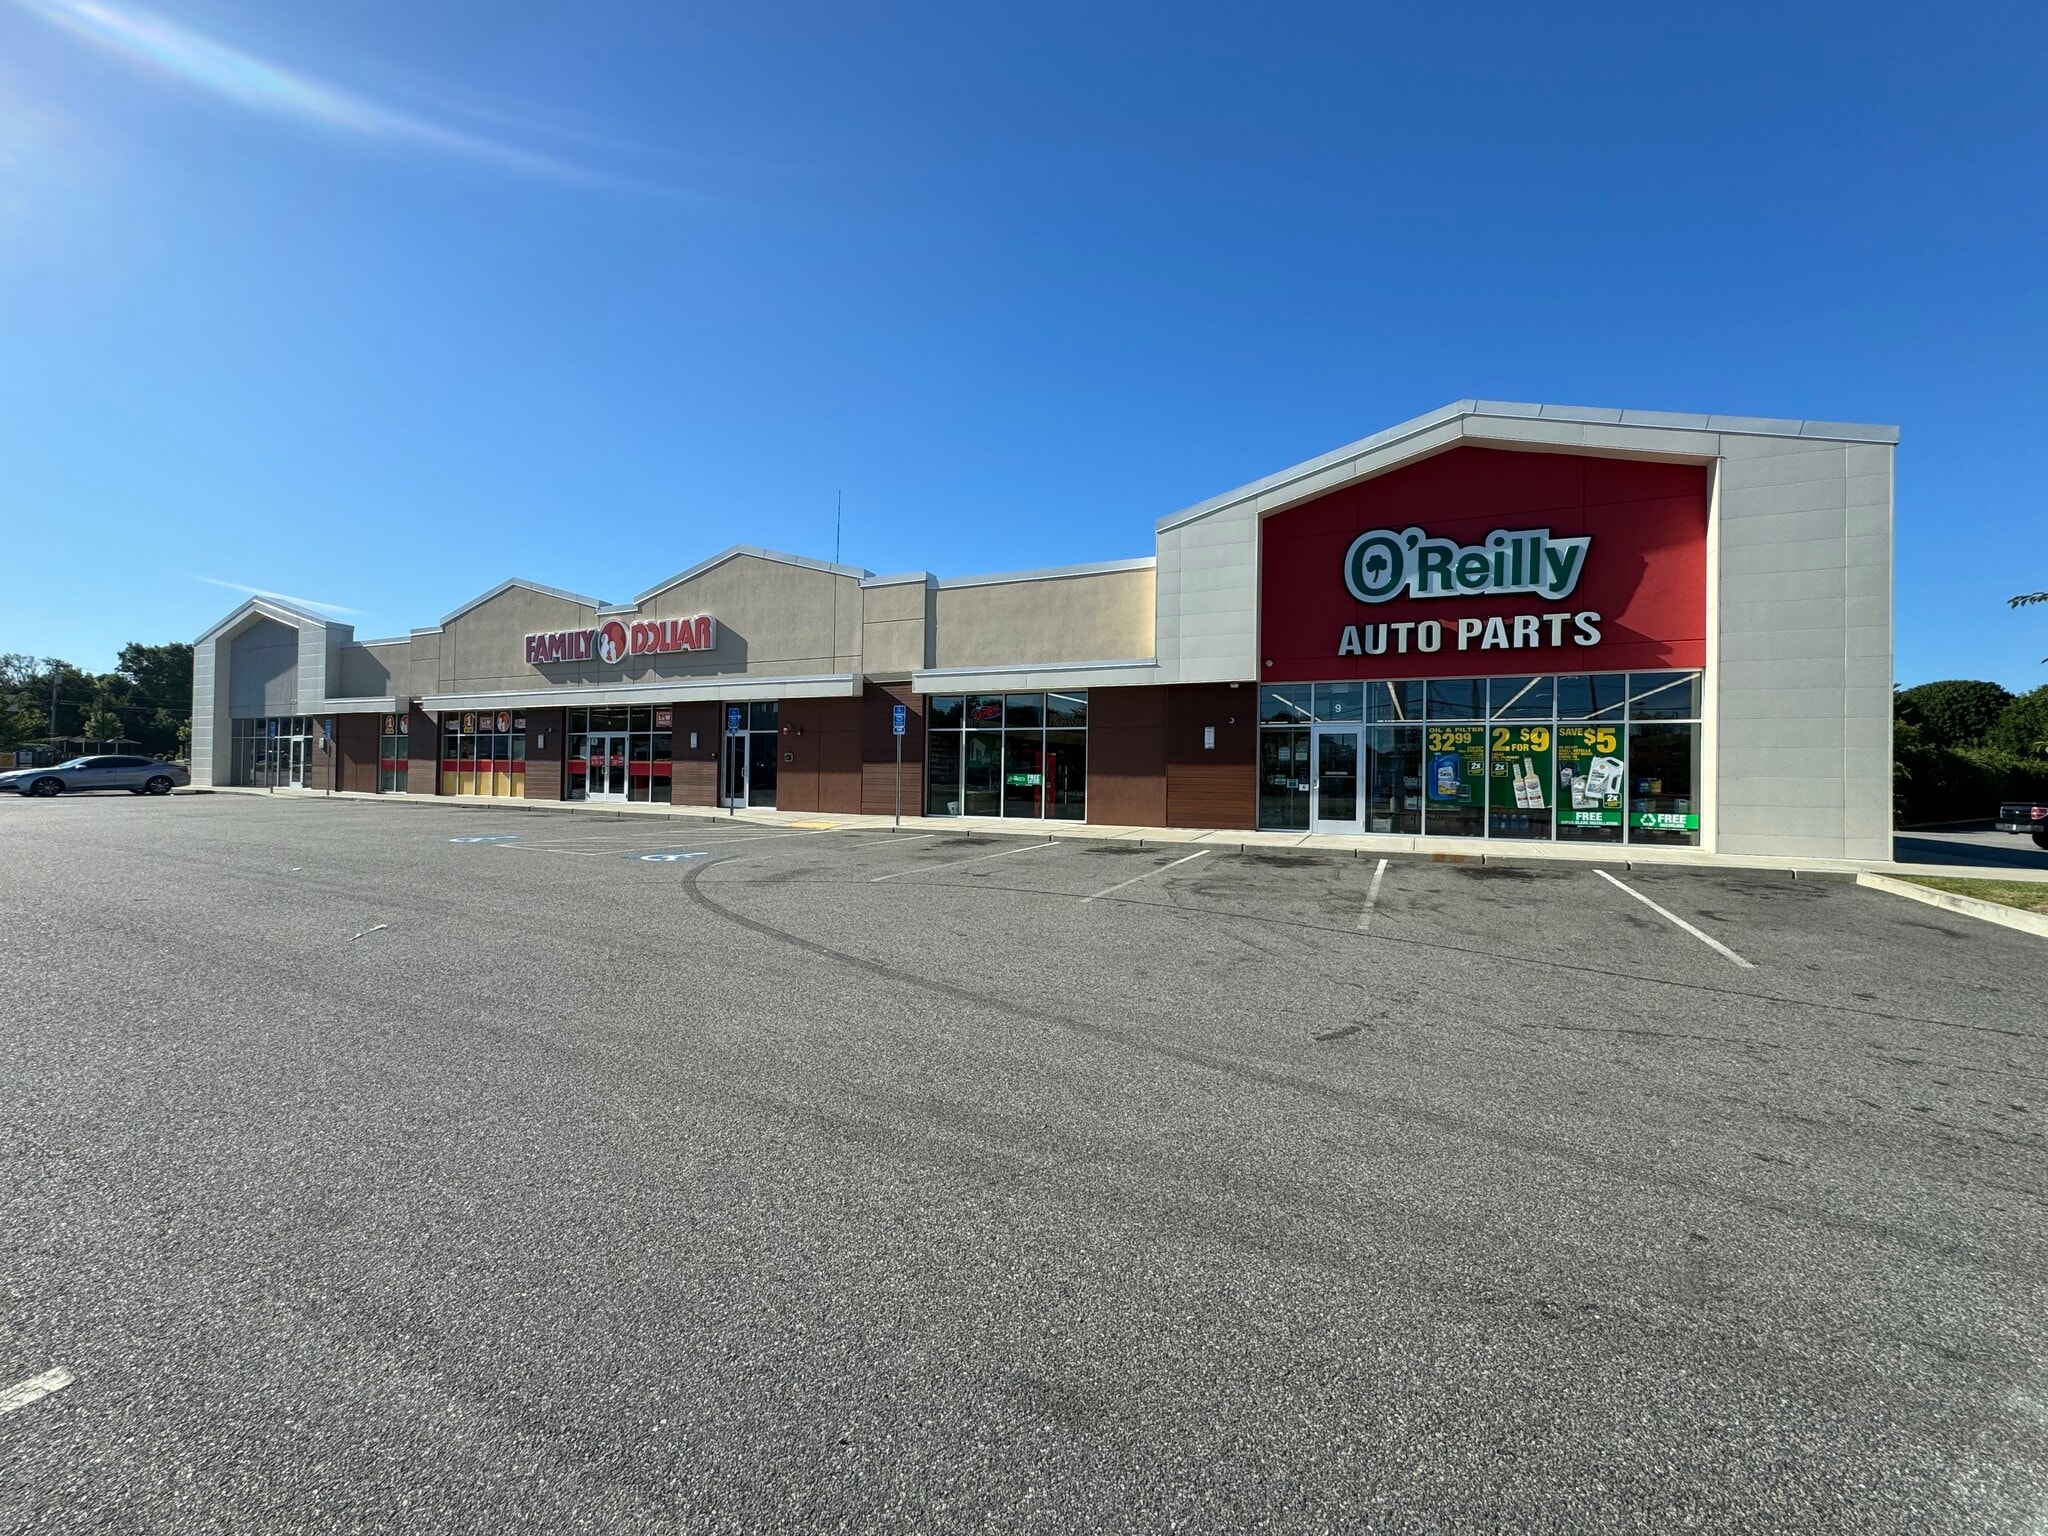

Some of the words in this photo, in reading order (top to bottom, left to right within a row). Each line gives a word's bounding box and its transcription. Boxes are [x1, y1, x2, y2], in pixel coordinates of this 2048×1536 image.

[1348, 530, 1587, 600] O'Reilly
[525, 630, 595, 663] FAMILY
[630, 614, 712, 655] DOLLAR
[1337, 620, 1442, 656] AUTO
[1457, 611, 1602, 650] PARTS
[1334, 704, 1342, 712] 9
[1492, 727, 1510, 752] 2
[1511, 743, 1530, 752] FOR
[1520, 727, 1550, 752] $9
[1559, 727, 1584, 737] SAVE
[1583, 727, 1617, 753] $5
[1575, 812, 1603, 821] FREE
[1657, 813, 1687, 824] FREE
